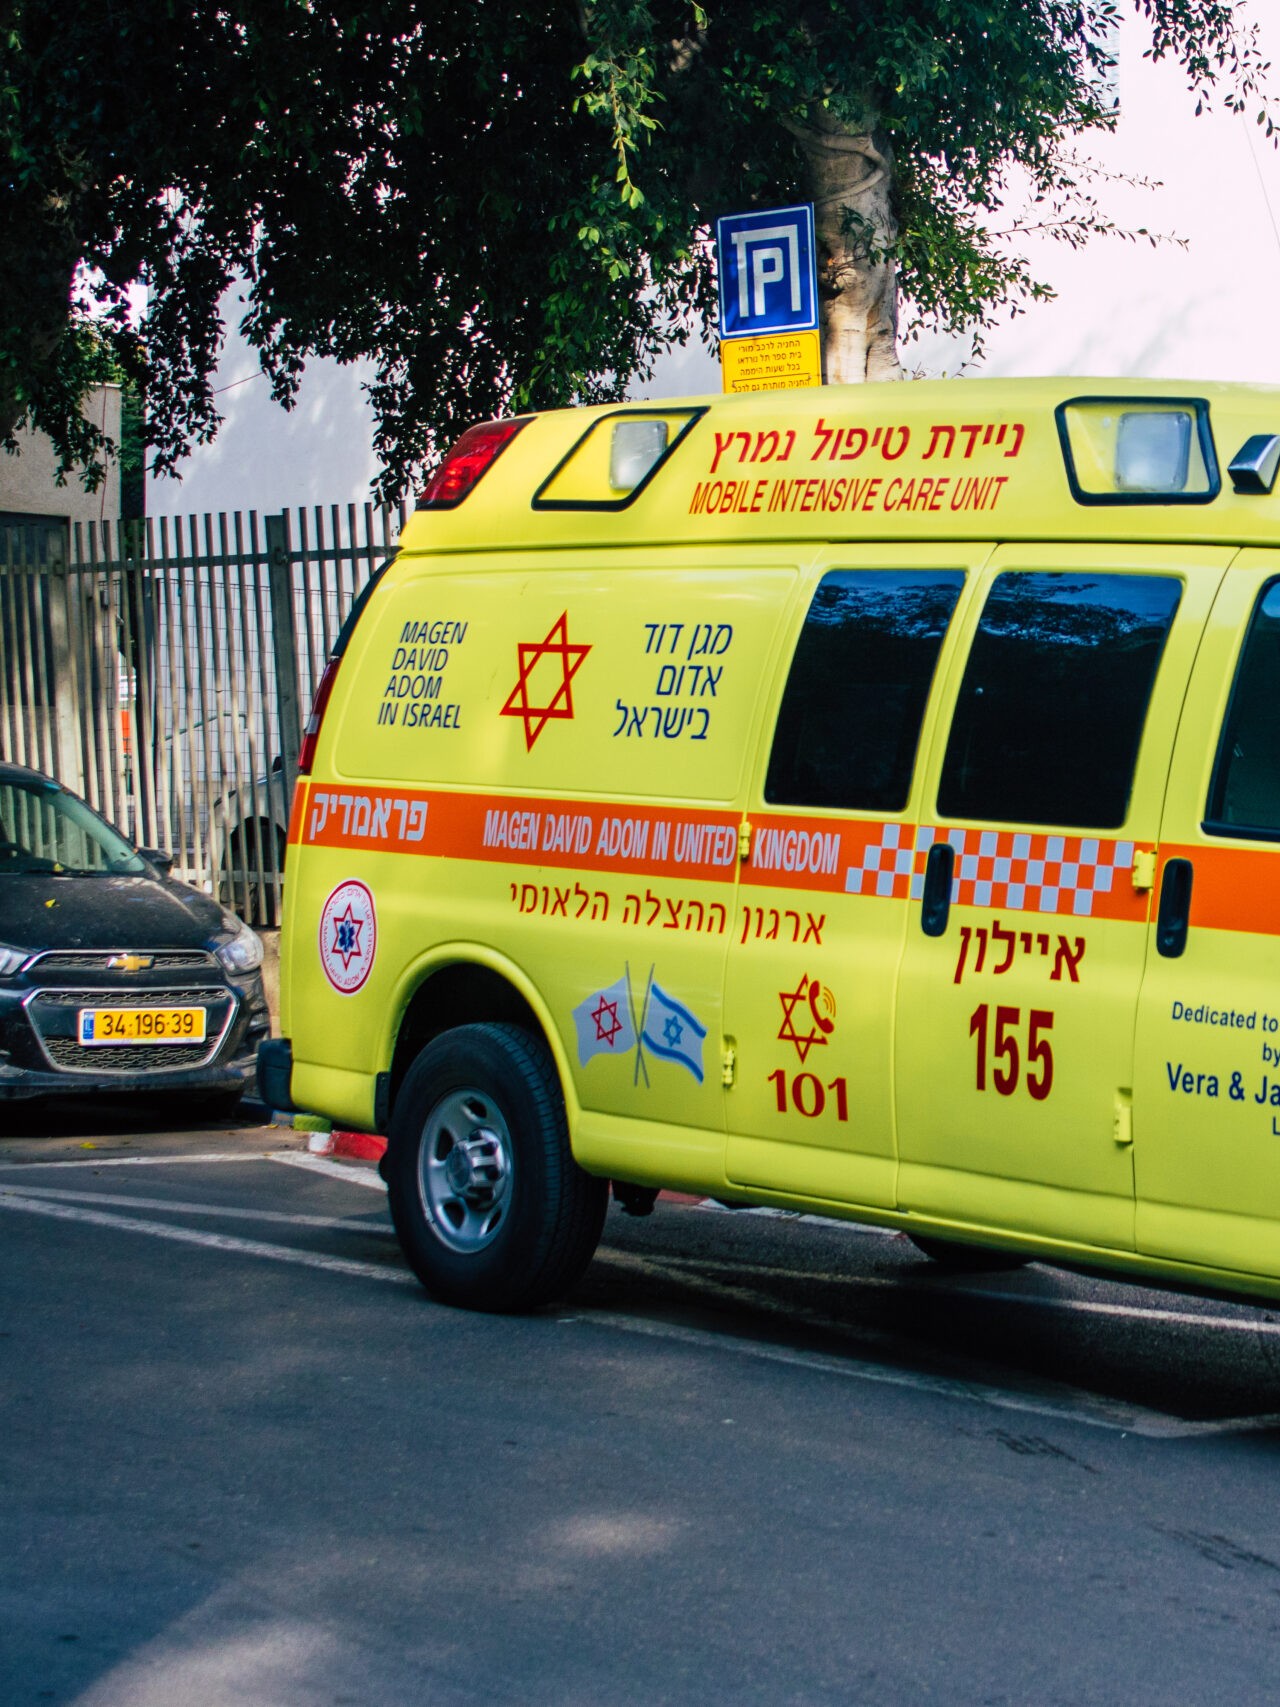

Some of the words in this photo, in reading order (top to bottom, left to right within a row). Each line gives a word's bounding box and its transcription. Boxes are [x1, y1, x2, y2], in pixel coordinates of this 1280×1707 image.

[752, 247, 784, 316] P
[709, 429, 796, 474] נמרץ
[810, 418, 911, 461] טיפול
[922, 423, 1026, 461] ניידת
[688, 479, 769, 515] MOBILE
[767, 477, 883, 513] INTENSIVE
[883, 477, 951, 512] CARE
[950, 476, 1009, 511] UNIT
[399, 621, 469, 644] MAGEN
[643, 623, 685, 654] דוד
[686, 623, 734, 661] מגן
[392, 648, 449, 672] DAVID
[384, 675, 443, 699] ADOM
[655, 665, 723, 697] אדום
[377, 702, 399, 725] IN
[401, 703, 462, 729] ISRAEL
[613, 699, 710, 740] בישראל
[309, 793, 428, 841] פראמדיק
[482, 809, 542, 850] MAGEN
[542, 813, 593, 854] DAVID
[595, 817, 650, 859] ADOM
[651, 821, 672, 861] IN
[673, 823, 737, 867] UNITED
[752, 828, 841, 875] KINGDOM
[511, 882, 609, 921] הלאומי
[622, 889, 727, 934] ההצלה
[740, 906, 826, 945] ארגון
[953, 919, 1086, 984] איילון
[1171, 1001, 1256, 1030] Dedicated
[1262, 1014, 1279, 1033] to
[969, 1003, 1054, 1101] 155
[767, 1069, 849, 1122] 101
[1166, 1062, 1219, 1098] Vera
[1228, 1070, 1246, 1101] &
